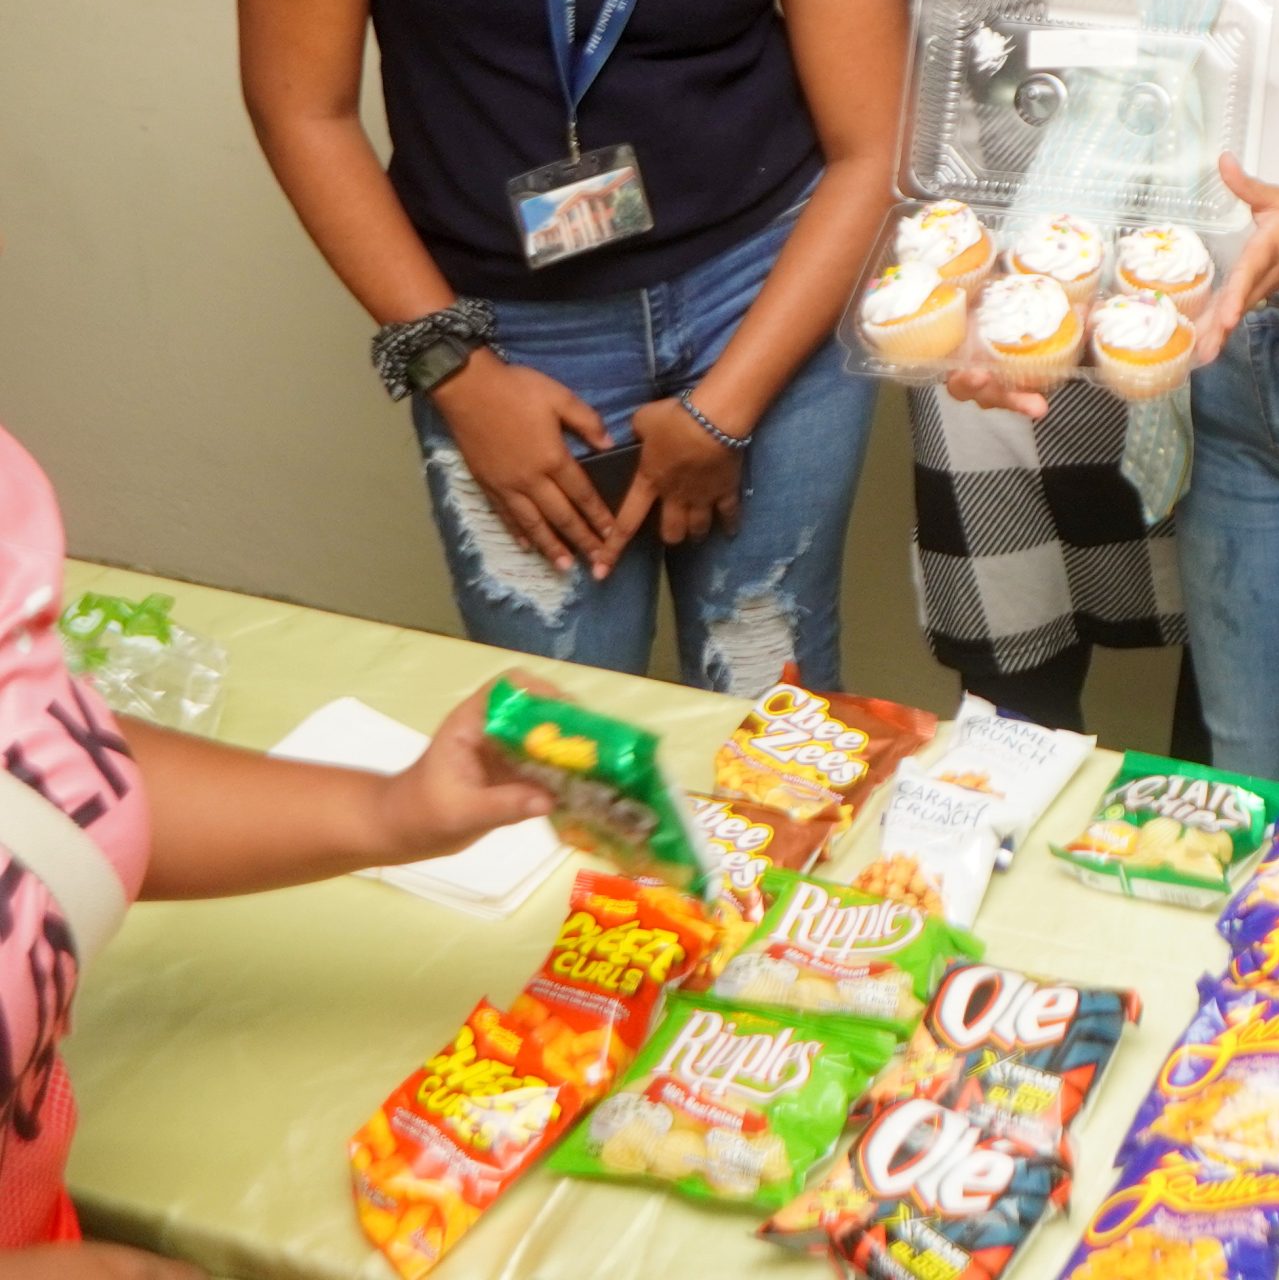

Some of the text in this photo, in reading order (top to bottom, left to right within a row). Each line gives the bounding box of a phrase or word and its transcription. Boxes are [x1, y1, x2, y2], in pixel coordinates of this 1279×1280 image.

[584, 31, 602, 56] THE
[754, 683, 866, 750] Chee
[751, 721, 866, 784] Zees
[694, 797, 772, 848] hee
[553, 951, 643, 996] CURLS
[653, 1008, 824, 1100] Ripples
